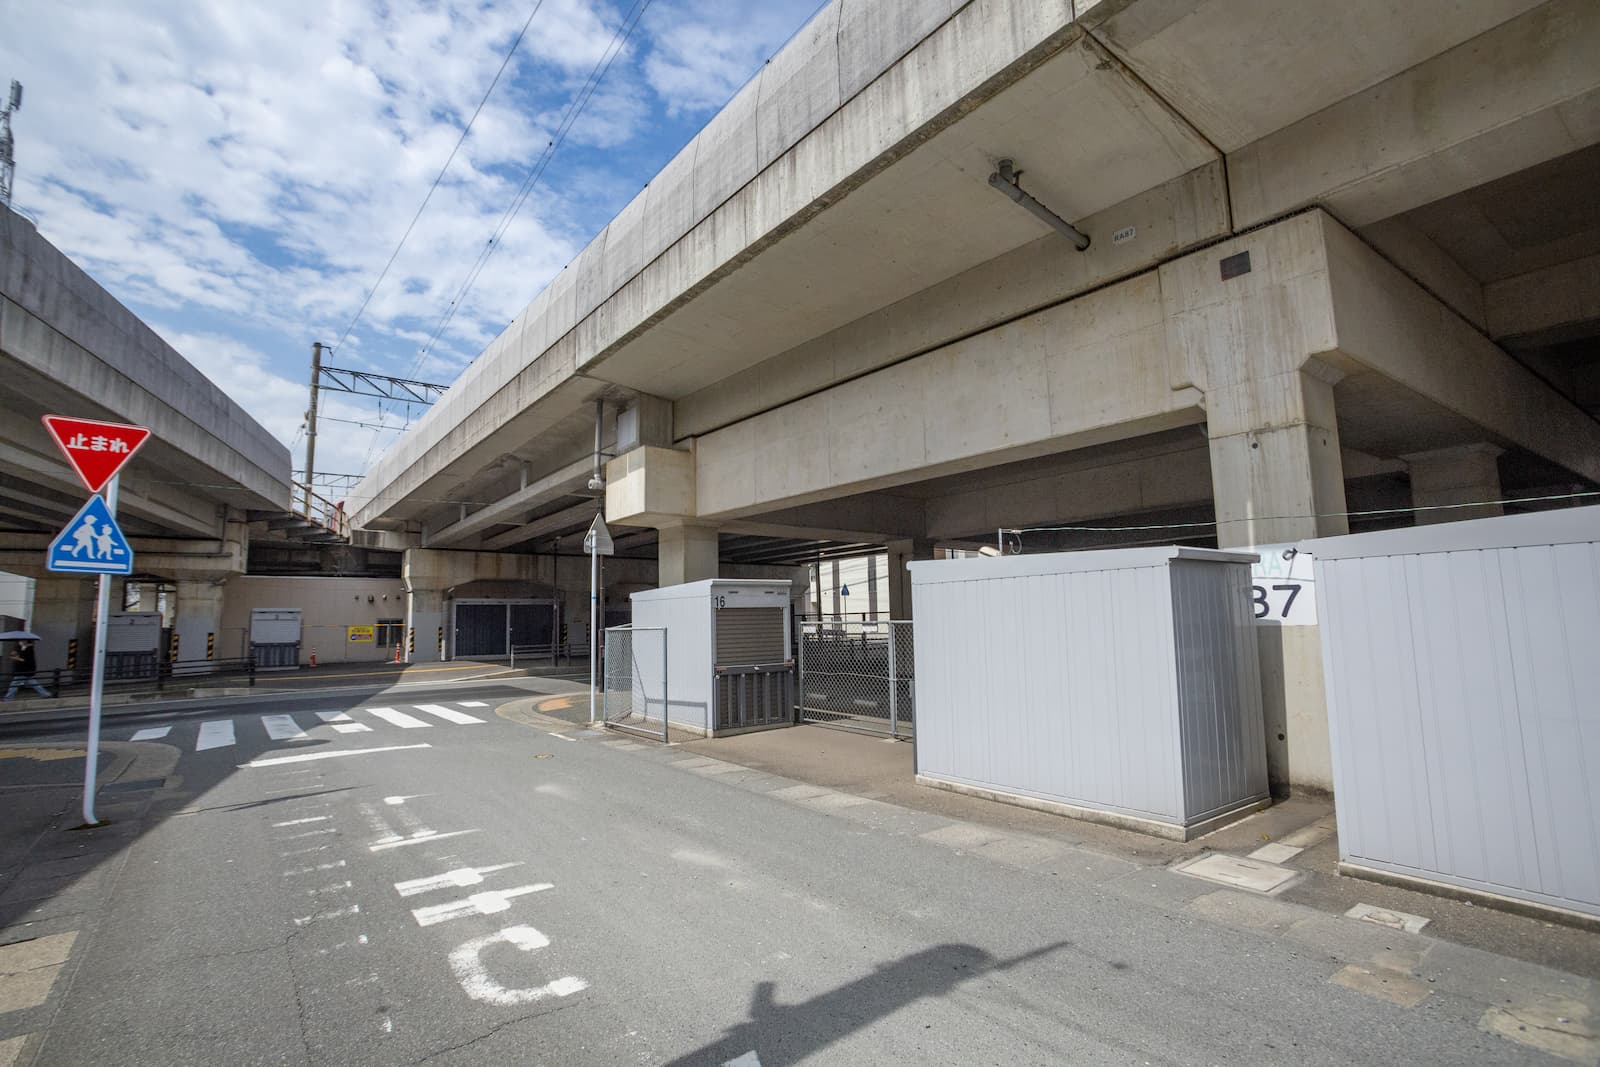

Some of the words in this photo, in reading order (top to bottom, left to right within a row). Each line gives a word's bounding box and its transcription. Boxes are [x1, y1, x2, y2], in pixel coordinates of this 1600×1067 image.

[66, 432, 130, 454] 止まれ
[714, 595, 726, 608] 16
